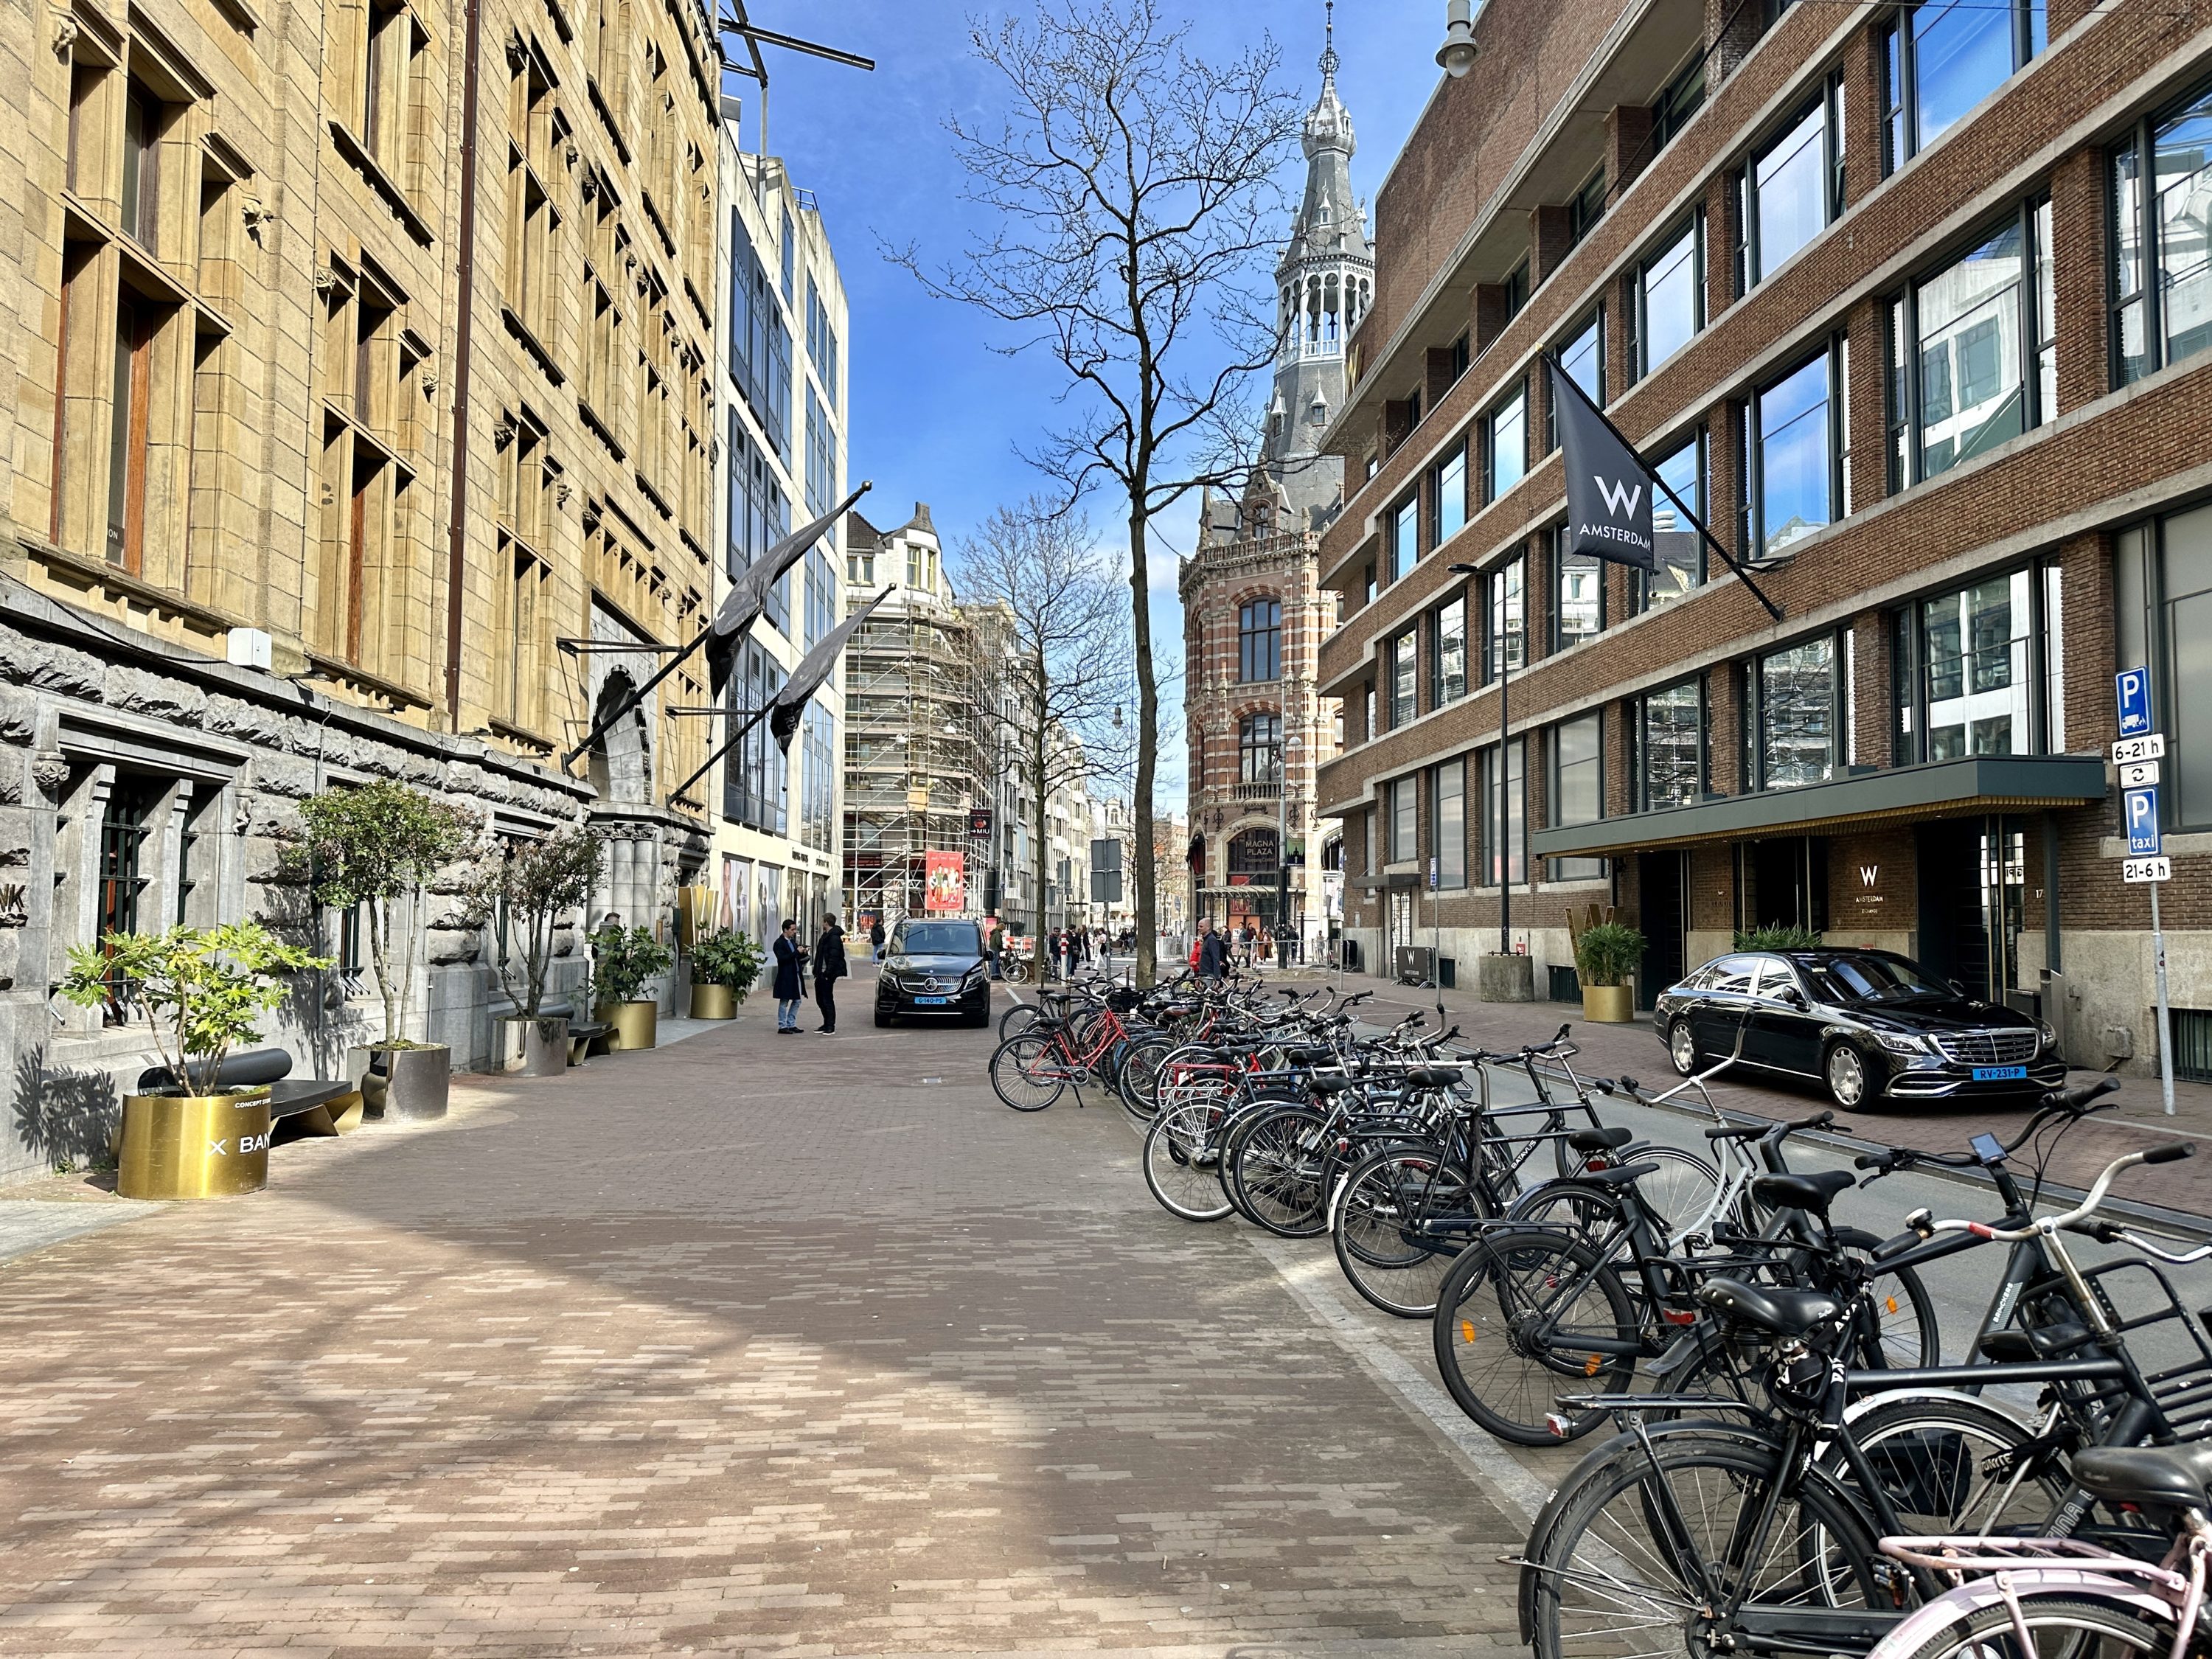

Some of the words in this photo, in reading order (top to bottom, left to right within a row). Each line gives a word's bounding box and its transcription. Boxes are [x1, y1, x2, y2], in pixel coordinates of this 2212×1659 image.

[1593, 476, 1641, 521] W
[1579, 523, 1651, 551] AMSTERDAM
[2123, 675, 2139, 708] P
[2115, 741, 2145, 759] 6-21
[2151, 740, 2159, 754] h
[2132, 796, 2149, 829] P
[1245, 840, 1274, 848] MAGNA
[2132, 835, 2154, 849] taxi
[1860, 865, 1878, 887] W
[2126, 863, 2153, 879] 21-6
[2158, 862, 2166, 877] h
[1856, 895, 1884, 903] AMSTERDAM
[1407, 950, 1415, 965] W
[1980, 1068, 2020, 1079] RV-231-P
[1511, 1140, 1537, 1169] BATAVUS
